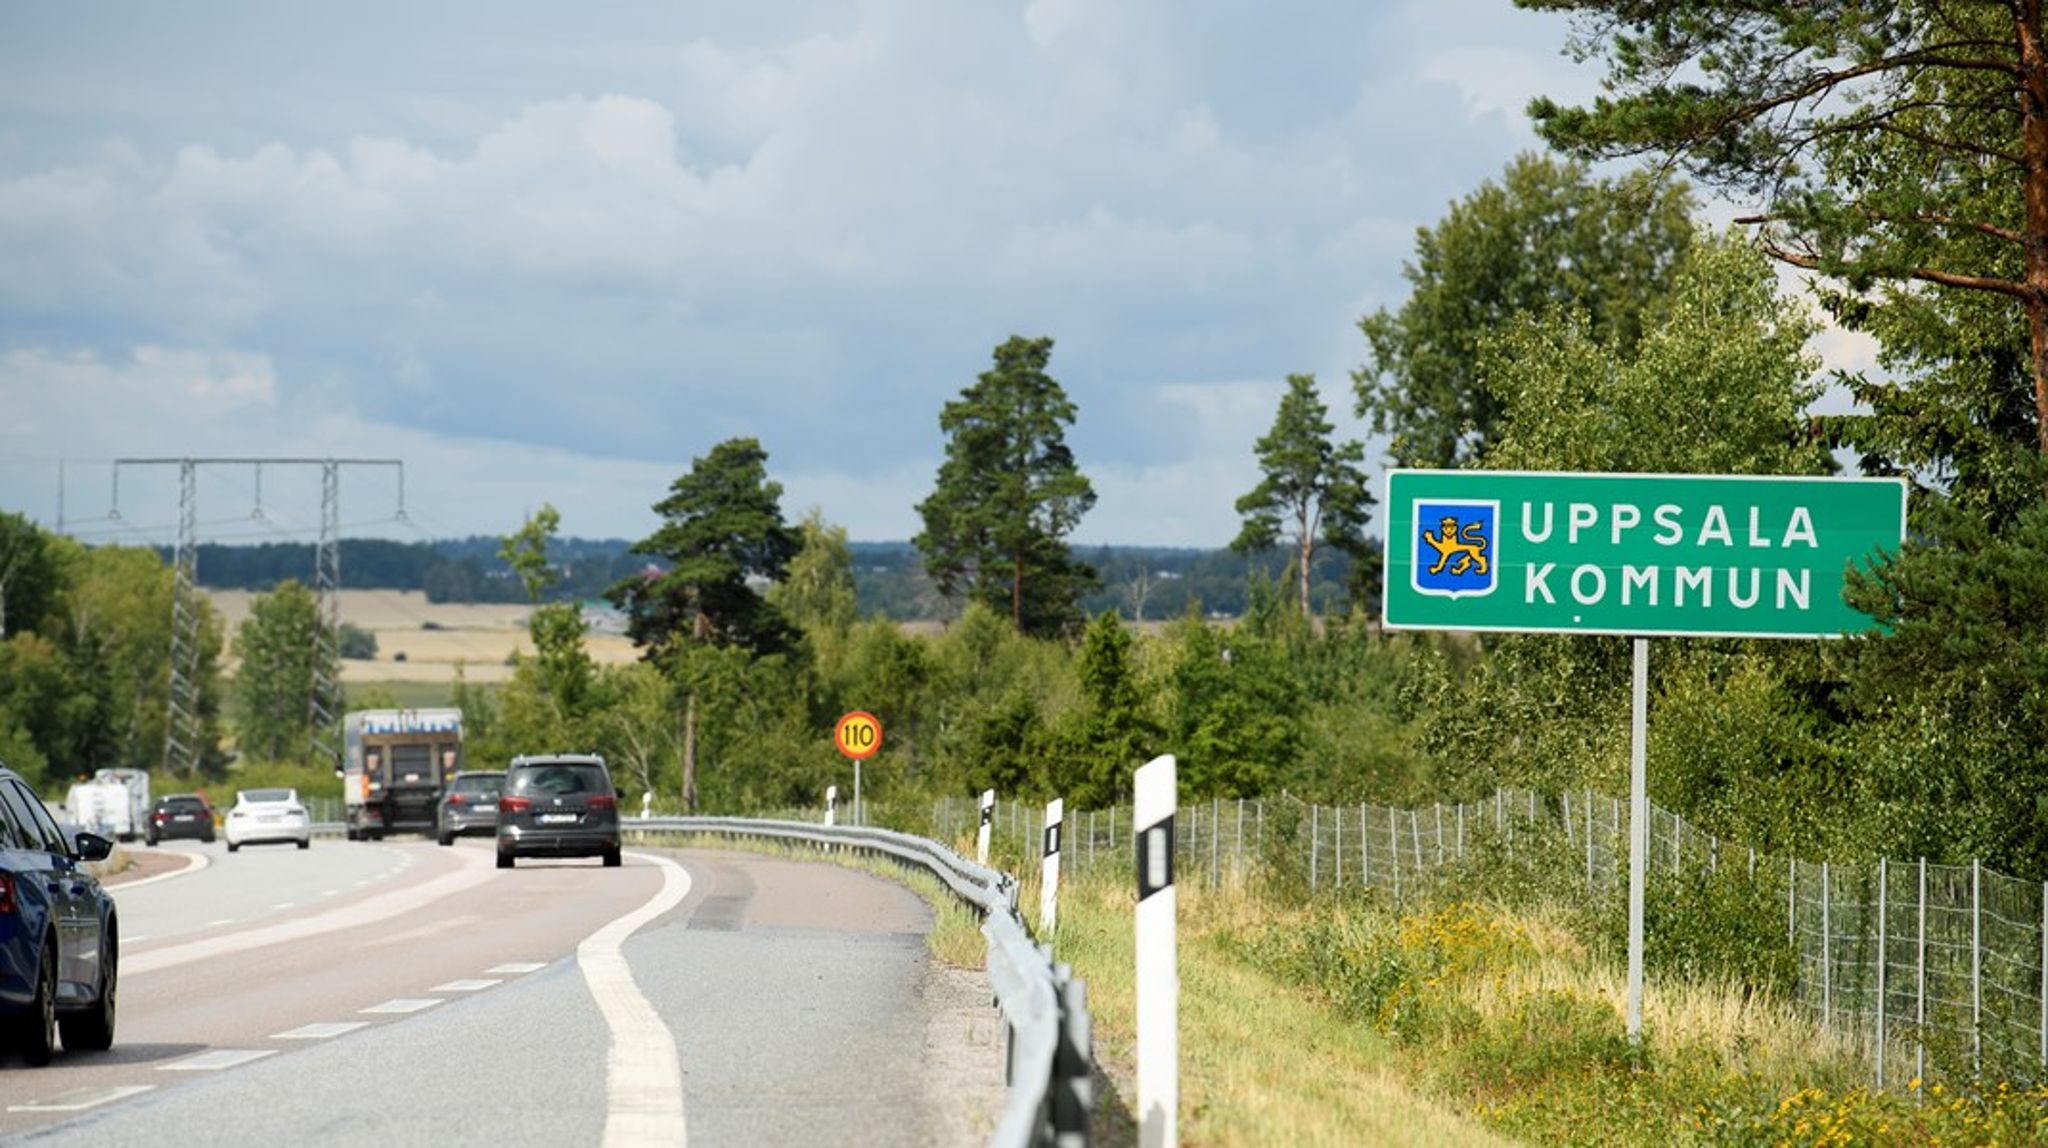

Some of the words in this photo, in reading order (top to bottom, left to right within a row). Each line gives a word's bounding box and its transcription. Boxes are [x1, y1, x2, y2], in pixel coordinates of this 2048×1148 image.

[1521, 501, 1818, 548] UPPSALA
[1525, 562, 1811, 610] KOMMUN
[844, 724, 874, 747] 110
